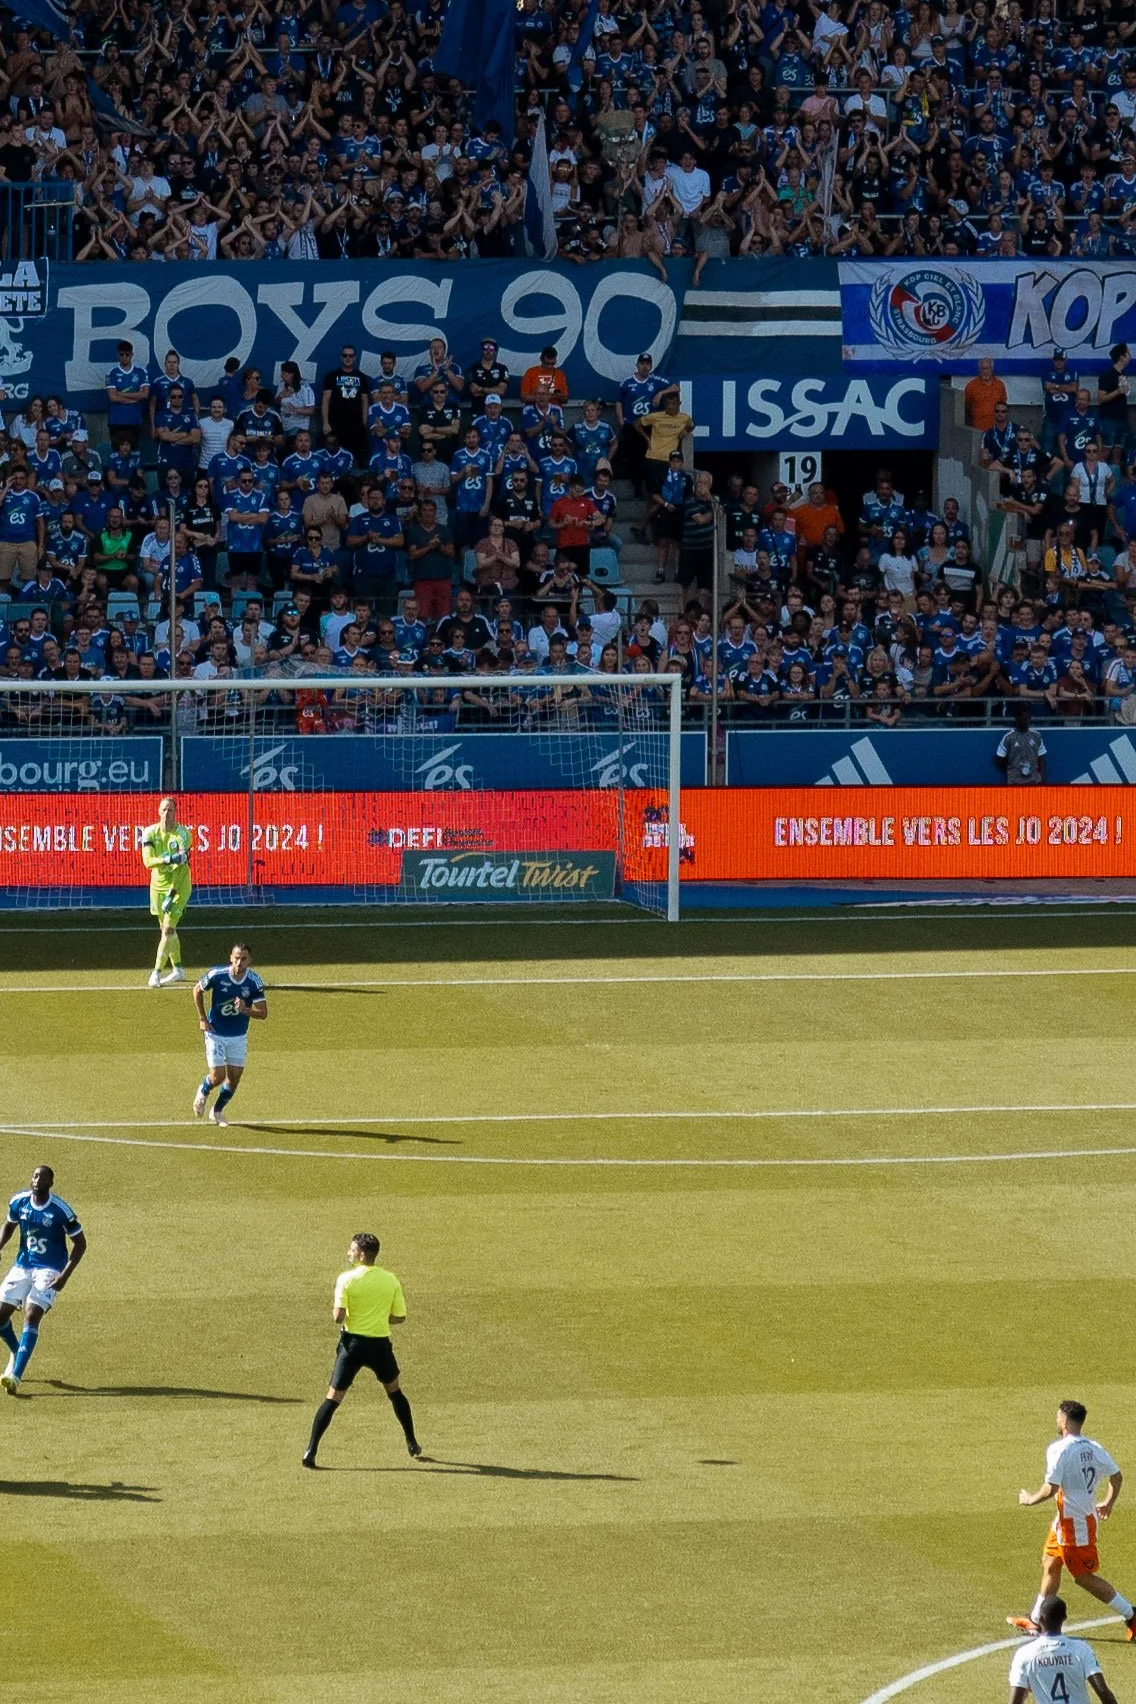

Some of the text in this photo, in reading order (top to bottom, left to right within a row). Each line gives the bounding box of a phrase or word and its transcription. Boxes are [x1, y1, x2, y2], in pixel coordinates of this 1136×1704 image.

[1005, 267, 1136, 349] KOP
[56, 274, 454, 393] BOYS
[498, 269, 679, 383] 90
[679, 377, 927, 439] LISSAC
[784, 455, 819, 484] 19
[103, 824, 146, 853] VER
[217, 824, 241, 852] JO
[251, 824, 310, 852] 2024
[774, 816, 895, 846] ENSEMBLE
[902, 816, 962, 846] VERS
[967, 815, 1009, 845] LES
[1014, 815, 1041, 845] JO
[1047, 815, 1109, 845] 2024
[418, 856, 630, 889] Tourtel Twist
[1050, 1672, 1070, 1704] 4
